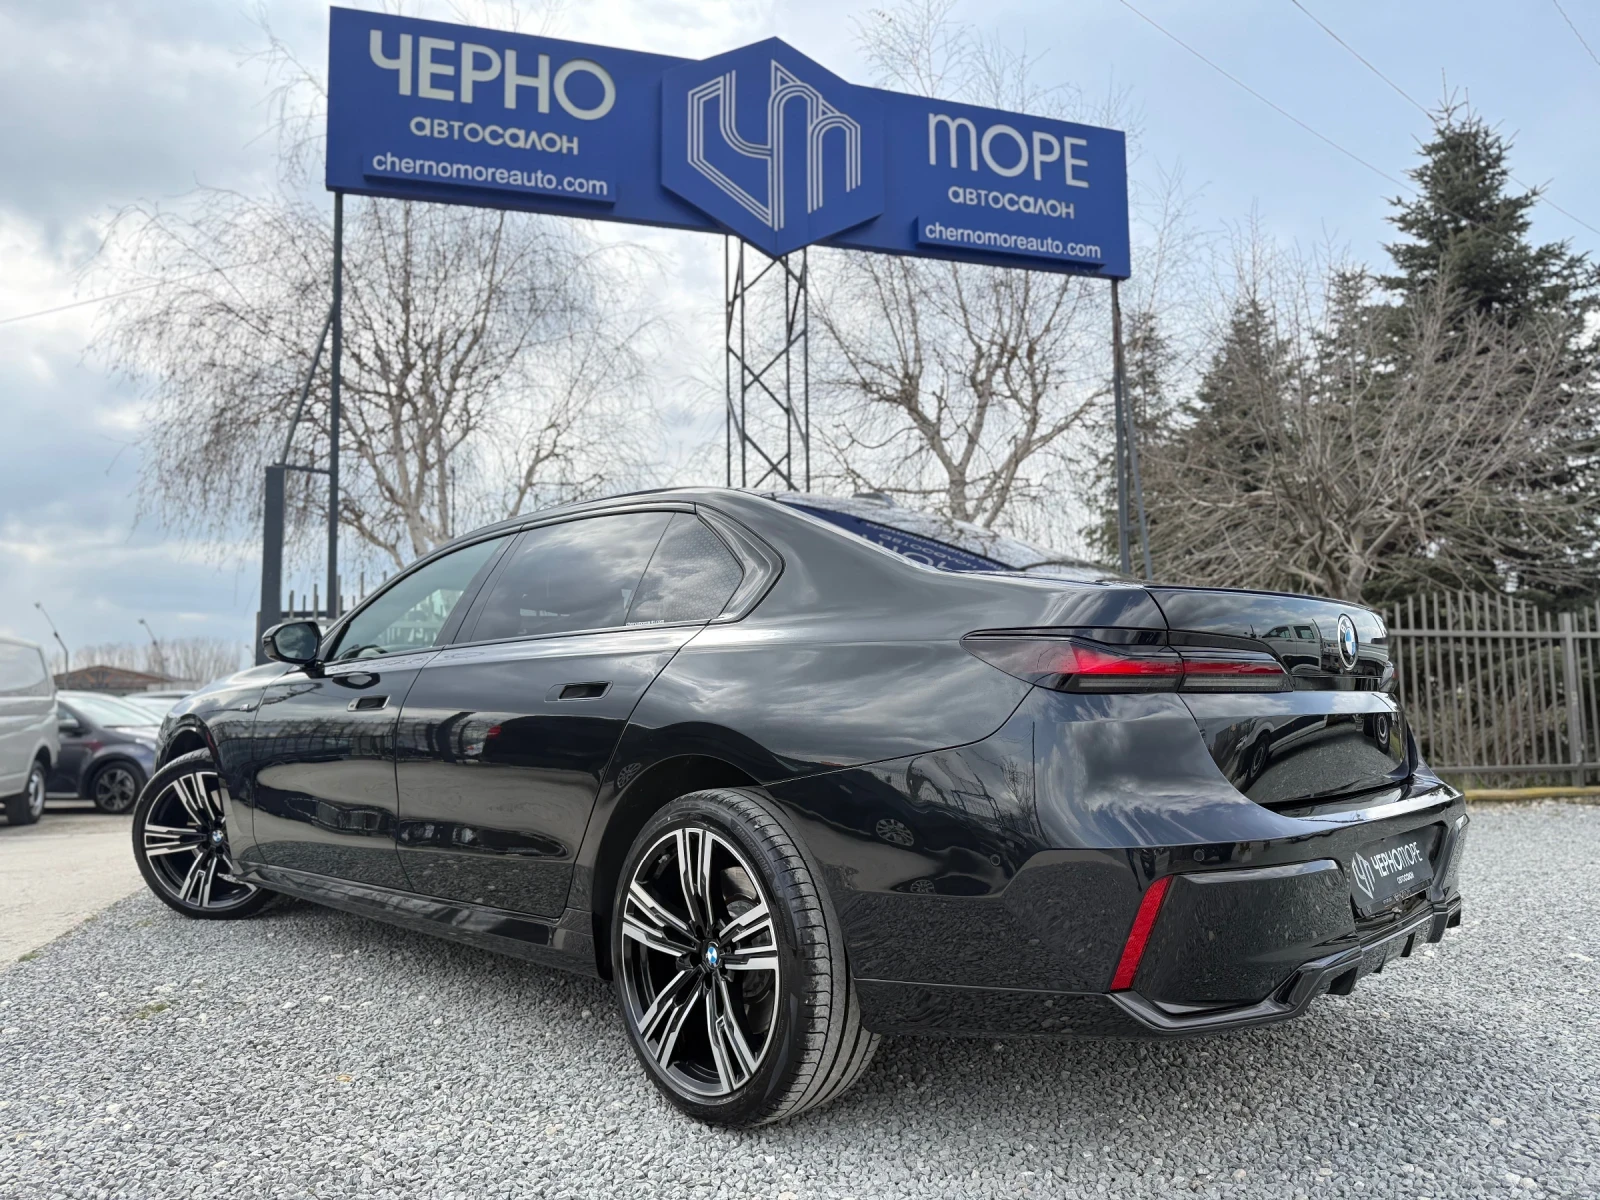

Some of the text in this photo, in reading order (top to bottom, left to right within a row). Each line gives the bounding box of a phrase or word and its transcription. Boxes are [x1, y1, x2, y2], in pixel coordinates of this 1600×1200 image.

[370, 30, 616, 120] ЧЕРНО
[372, 152, 608, 195] chernomoreauto.com
[925, 222, 1101, 258] chernomoreauto.com
